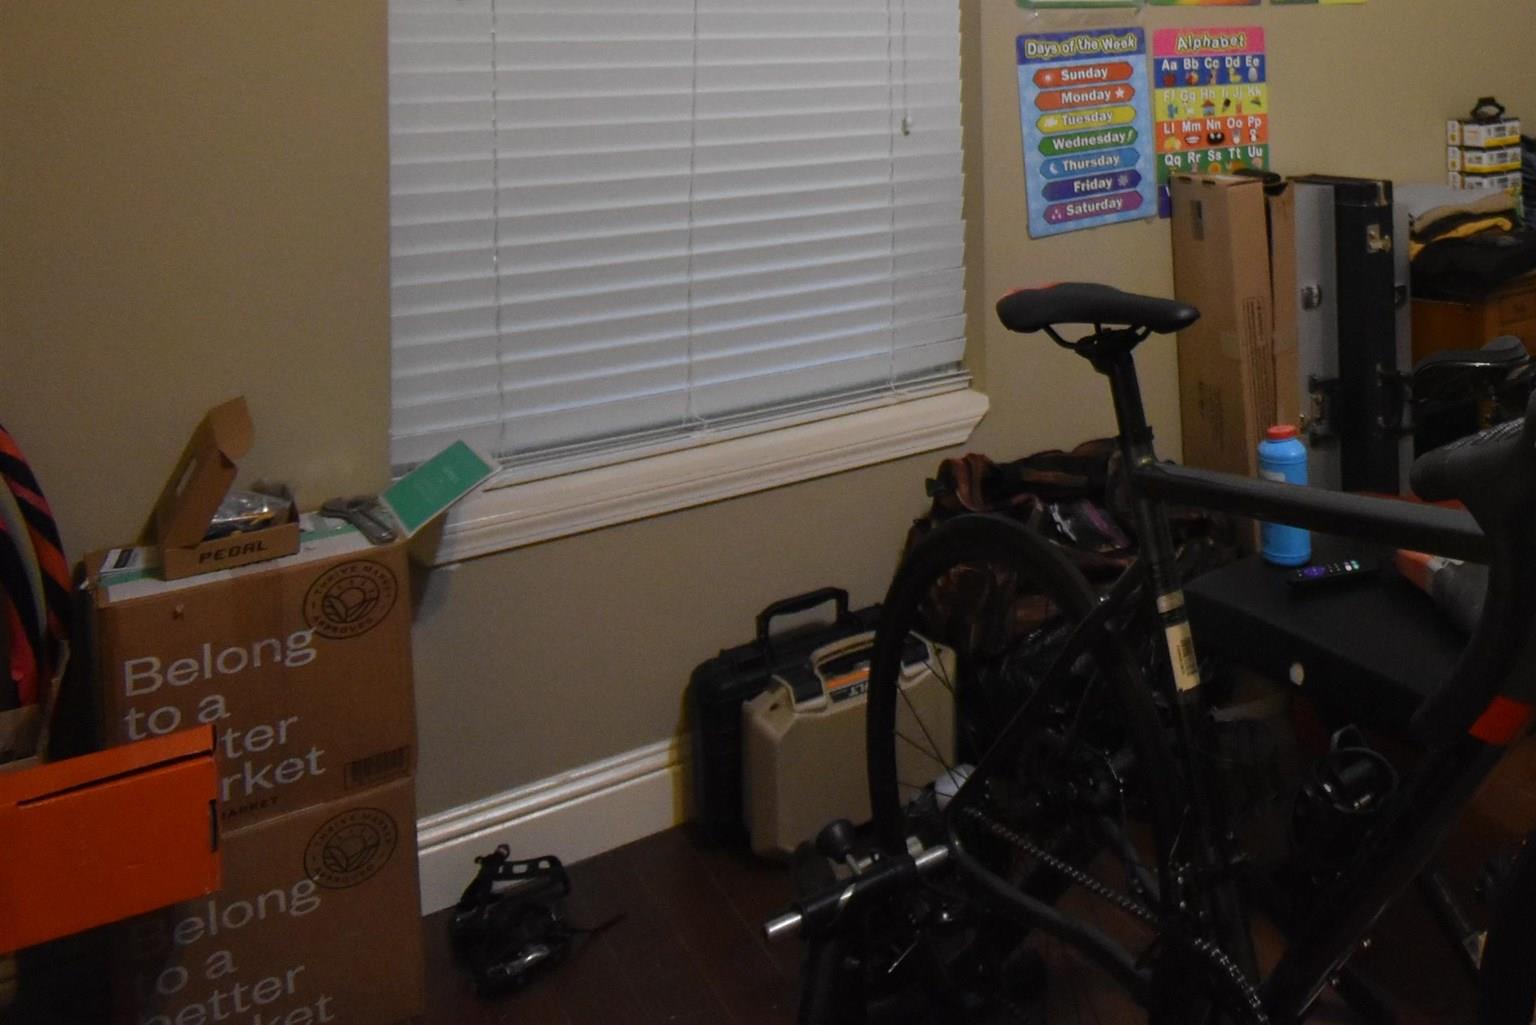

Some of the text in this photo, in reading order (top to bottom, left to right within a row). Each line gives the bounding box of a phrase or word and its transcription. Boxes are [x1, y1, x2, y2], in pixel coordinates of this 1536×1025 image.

[1027, 34, 1136, 56] Days of the Week
[1177, 34, 1245, 50] Alphabet
[1161, 55, 1260, 71] Aa Bb Cc Dd Ee
[1061, 67, 1109, 80] Sunday
[1061, 88, 1112, 104] Monday
[1062, 111, 1113, 126] Tuesday
[1163, 116, 1262, 134] Ll Mm Nn Oo Pp
[1052, 131, 1126, 150] Wednesday
[1062, 154, 1120, 171] Thursday
[1164, 146, 1263, 167] Qq Rr Ss Tt Uu
[1073, 177, 1112, 192] Friday
[1066, 197, 1123, 216] Saturday
[199, 540, 267, 564] PEDAL
[124, 627, 317, 696] Belong
[124, 694, 231, 740] to a
[221, 715, 299, 759] ter
[222, 747, 326, 801] rket
[173, 874, 321, 945] elong
[204, 950, 238, 979] a
